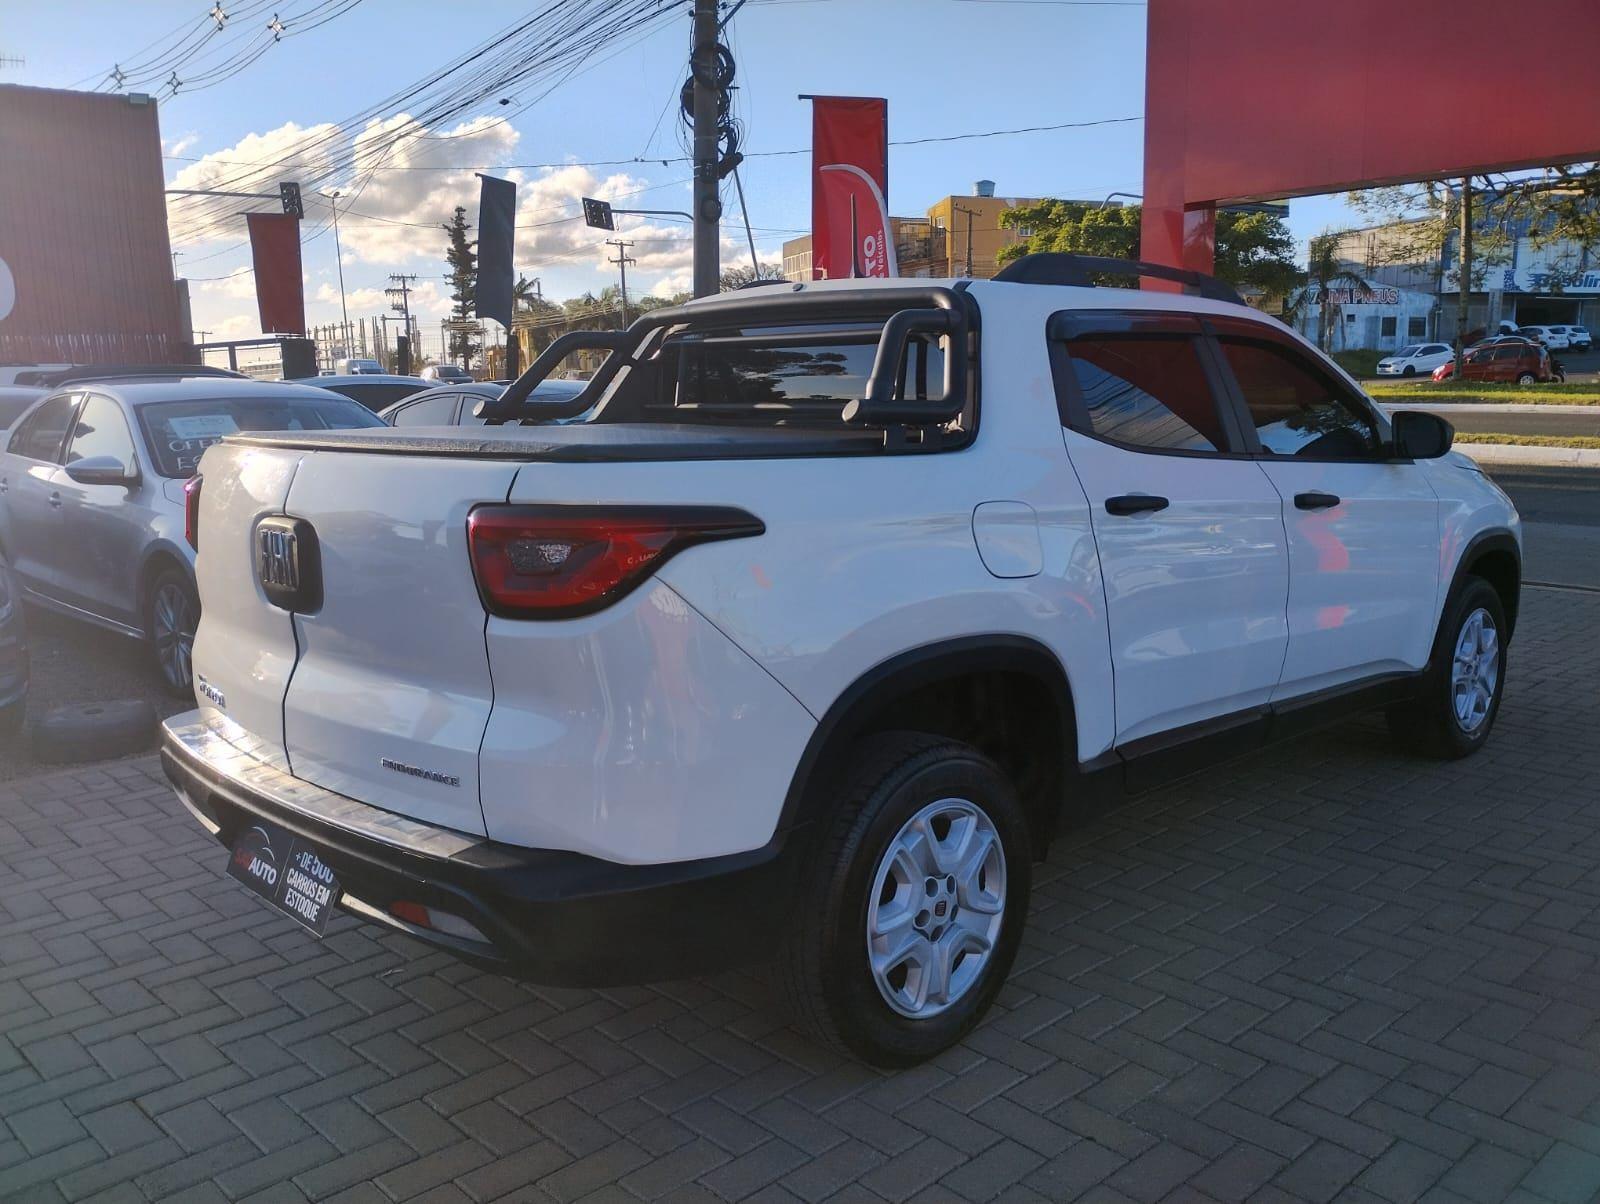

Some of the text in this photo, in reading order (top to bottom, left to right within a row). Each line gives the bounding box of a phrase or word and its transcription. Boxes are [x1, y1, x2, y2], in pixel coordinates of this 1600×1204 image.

[380, 757, 461, 787] ENDURANCE
[299, 851, 314, 872] DE
[286, 867, 331, 906] CARROS EM
[284, 887, 320, 922] ESTOQUE
